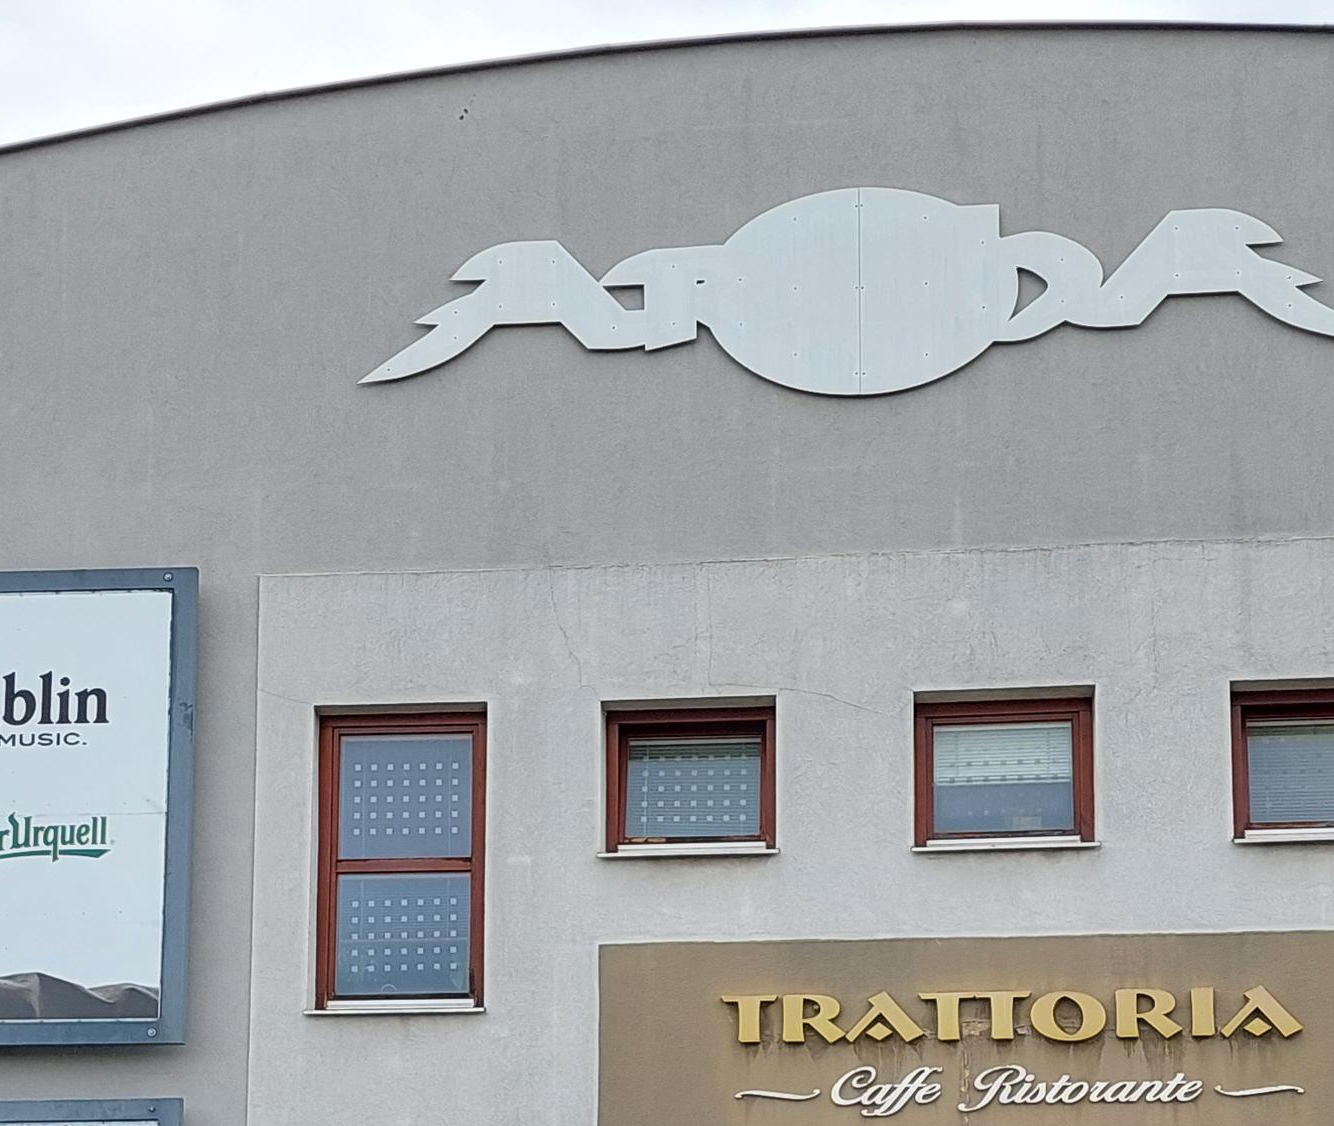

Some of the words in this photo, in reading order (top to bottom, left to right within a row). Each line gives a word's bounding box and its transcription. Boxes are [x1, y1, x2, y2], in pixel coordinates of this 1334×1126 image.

[8, 812, 108, 863] Urquell
[720, 985, 1304, 1044] TRATTORIA
[830, 1065, 944, 1117] Caffe
[957, 1064, 1204, 1113] Ristorante
